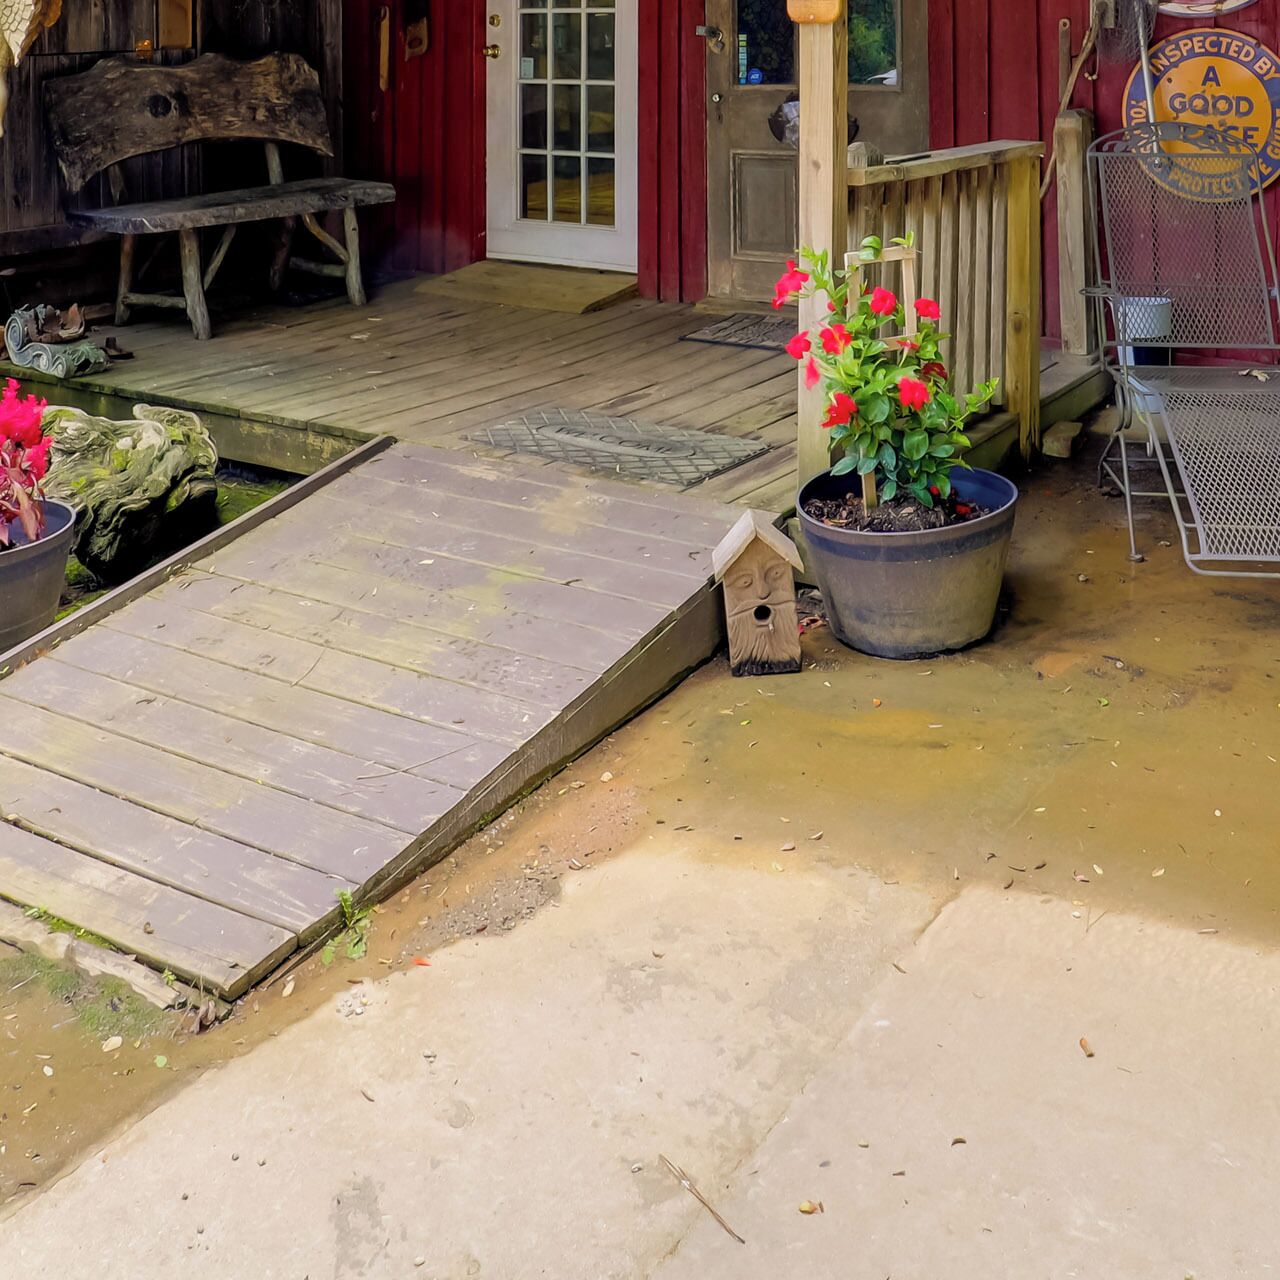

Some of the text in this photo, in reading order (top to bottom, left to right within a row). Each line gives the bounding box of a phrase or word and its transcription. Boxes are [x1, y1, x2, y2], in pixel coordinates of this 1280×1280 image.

[1149, 35, 1280, 81] INSPECTED BY
[1201, 64, 1221, 87] A
[1169, 92, 1254, 118] GOOD
